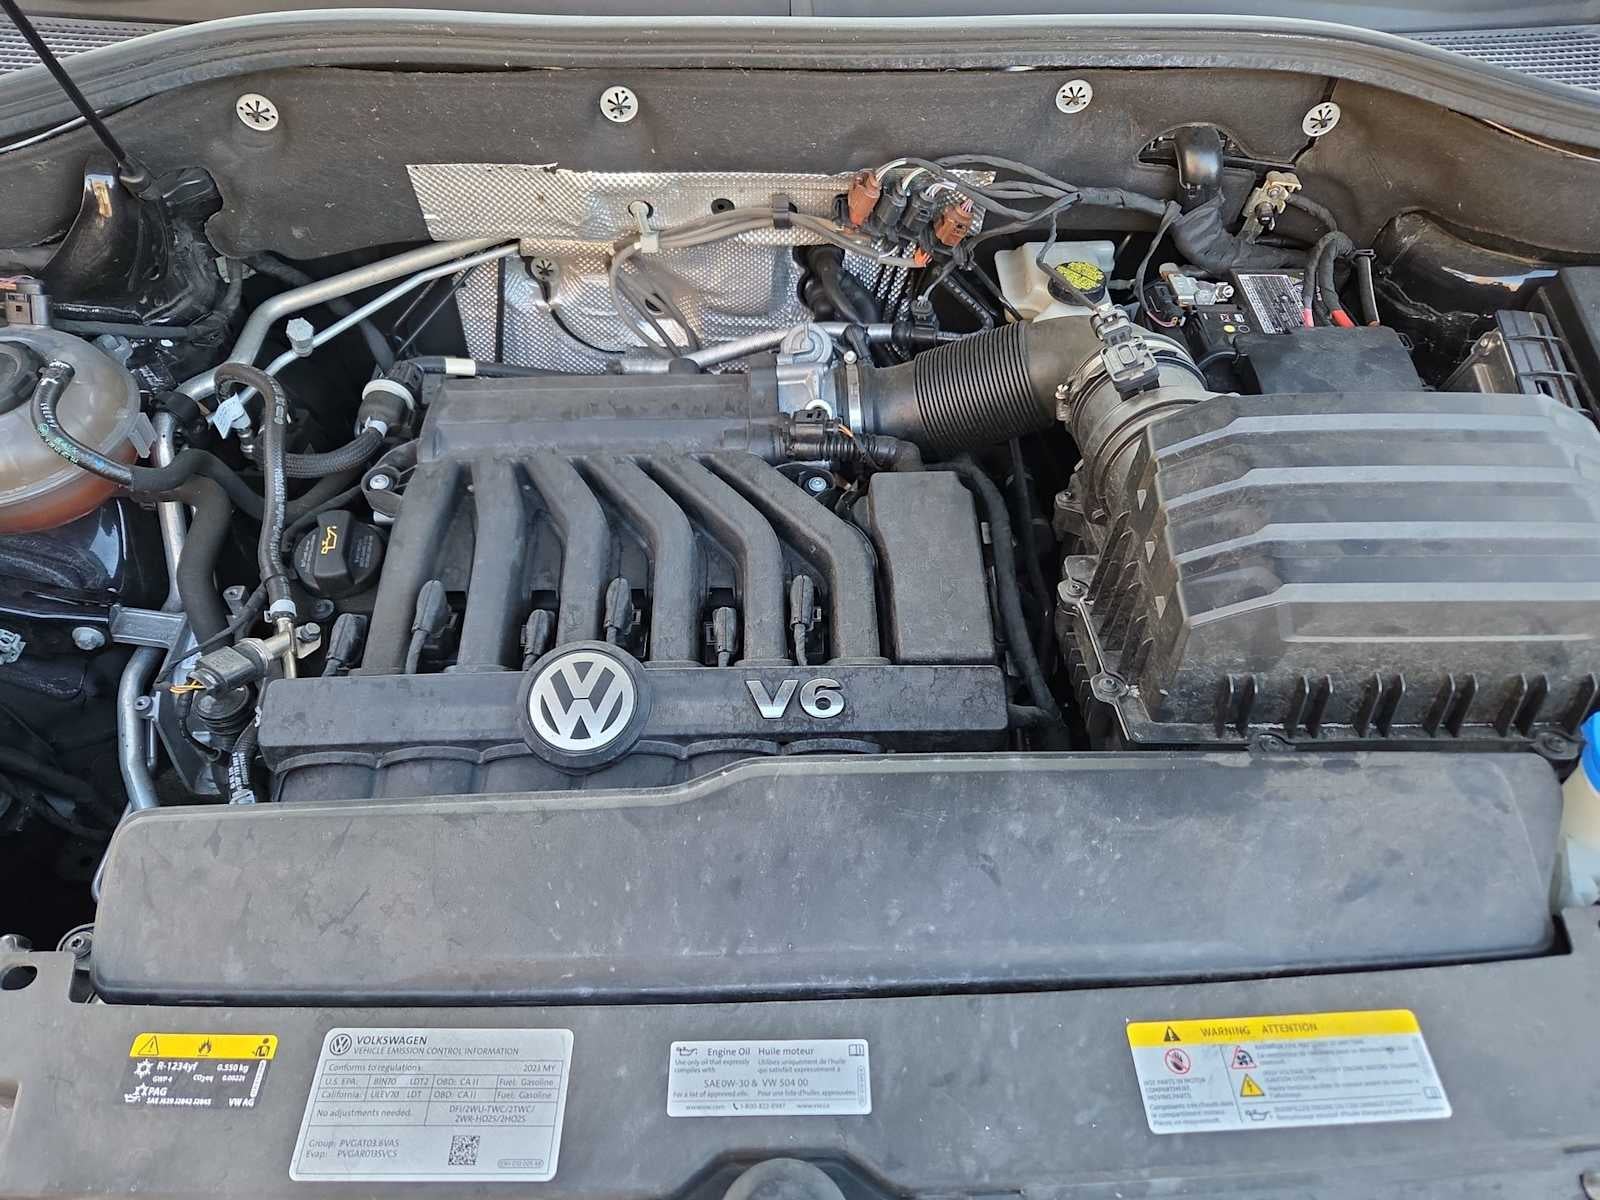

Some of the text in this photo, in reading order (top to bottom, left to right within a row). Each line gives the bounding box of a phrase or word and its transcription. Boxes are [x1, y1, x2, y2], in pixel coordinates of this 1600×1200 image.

[746, 677, 846, 719] V6
[1200, 1022, 1318, 1038] WARNING ATTENTION
[356, 1036, 428, 1045] VOLKSWAGEN
[353, 1047, 521, 1056] VEHICLE EMISSION CONTROL INFORMATION
[707, 1047, 751, 1058] Engine Oil
[758, 1047, 815, 1056] Huile moteur
[156, 1062, 199, 1073] R-1234yf
[238, 1064, 249, 1074] kg
[328, 1063, 366, 1072] Conforms
[542, 1064, 556, 1073] MY
[373, 1077, 397, 1086] BIN70
[409, 1077, 429, 1086] LDT2
[521, 1078, 554, 1087] Gasoline
[703, 1079, 809, 1089] SAE 0W-30 & VW 504 00
[147, 1086, 168, 1096] PAG
[518, 1091, 552, 1100] Gasoline
[229, 1098, 255, 1107] VW AG
[317, 1109, 328, 1117] No
[329, 1109, 379, 1119] adjustments
